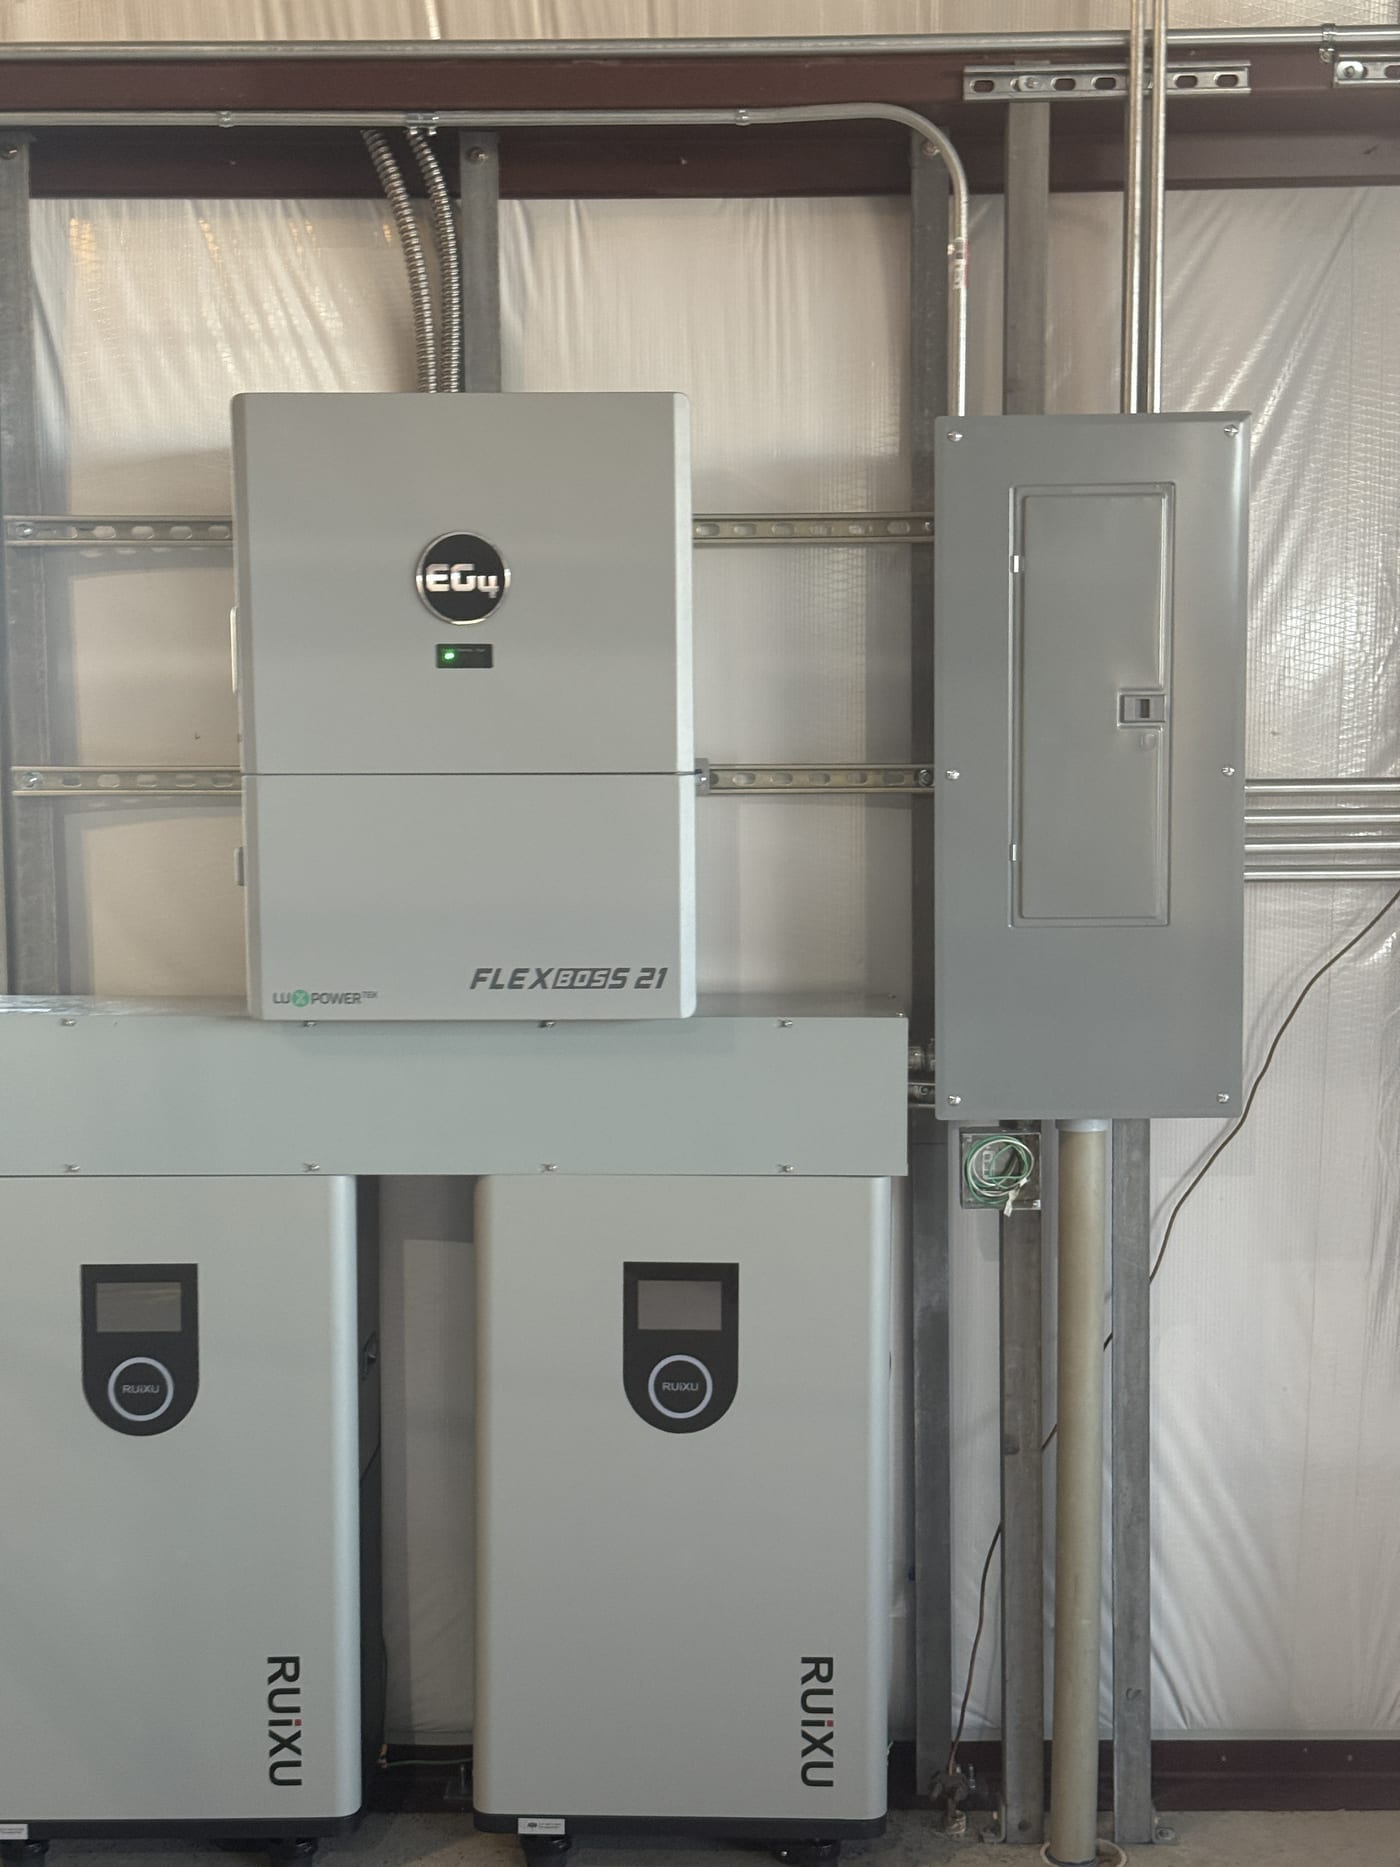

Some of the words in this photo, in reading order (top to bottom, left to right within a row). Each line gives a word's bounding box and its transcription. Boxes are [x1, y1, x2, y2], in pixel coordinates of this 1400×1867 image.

[426, 563, 499, 598] EG4
[634, 967, 669, 990] 21
[267, 1655, 303, 1787] RUiXU
[800, 1656, 834, 1788] RUiXU
